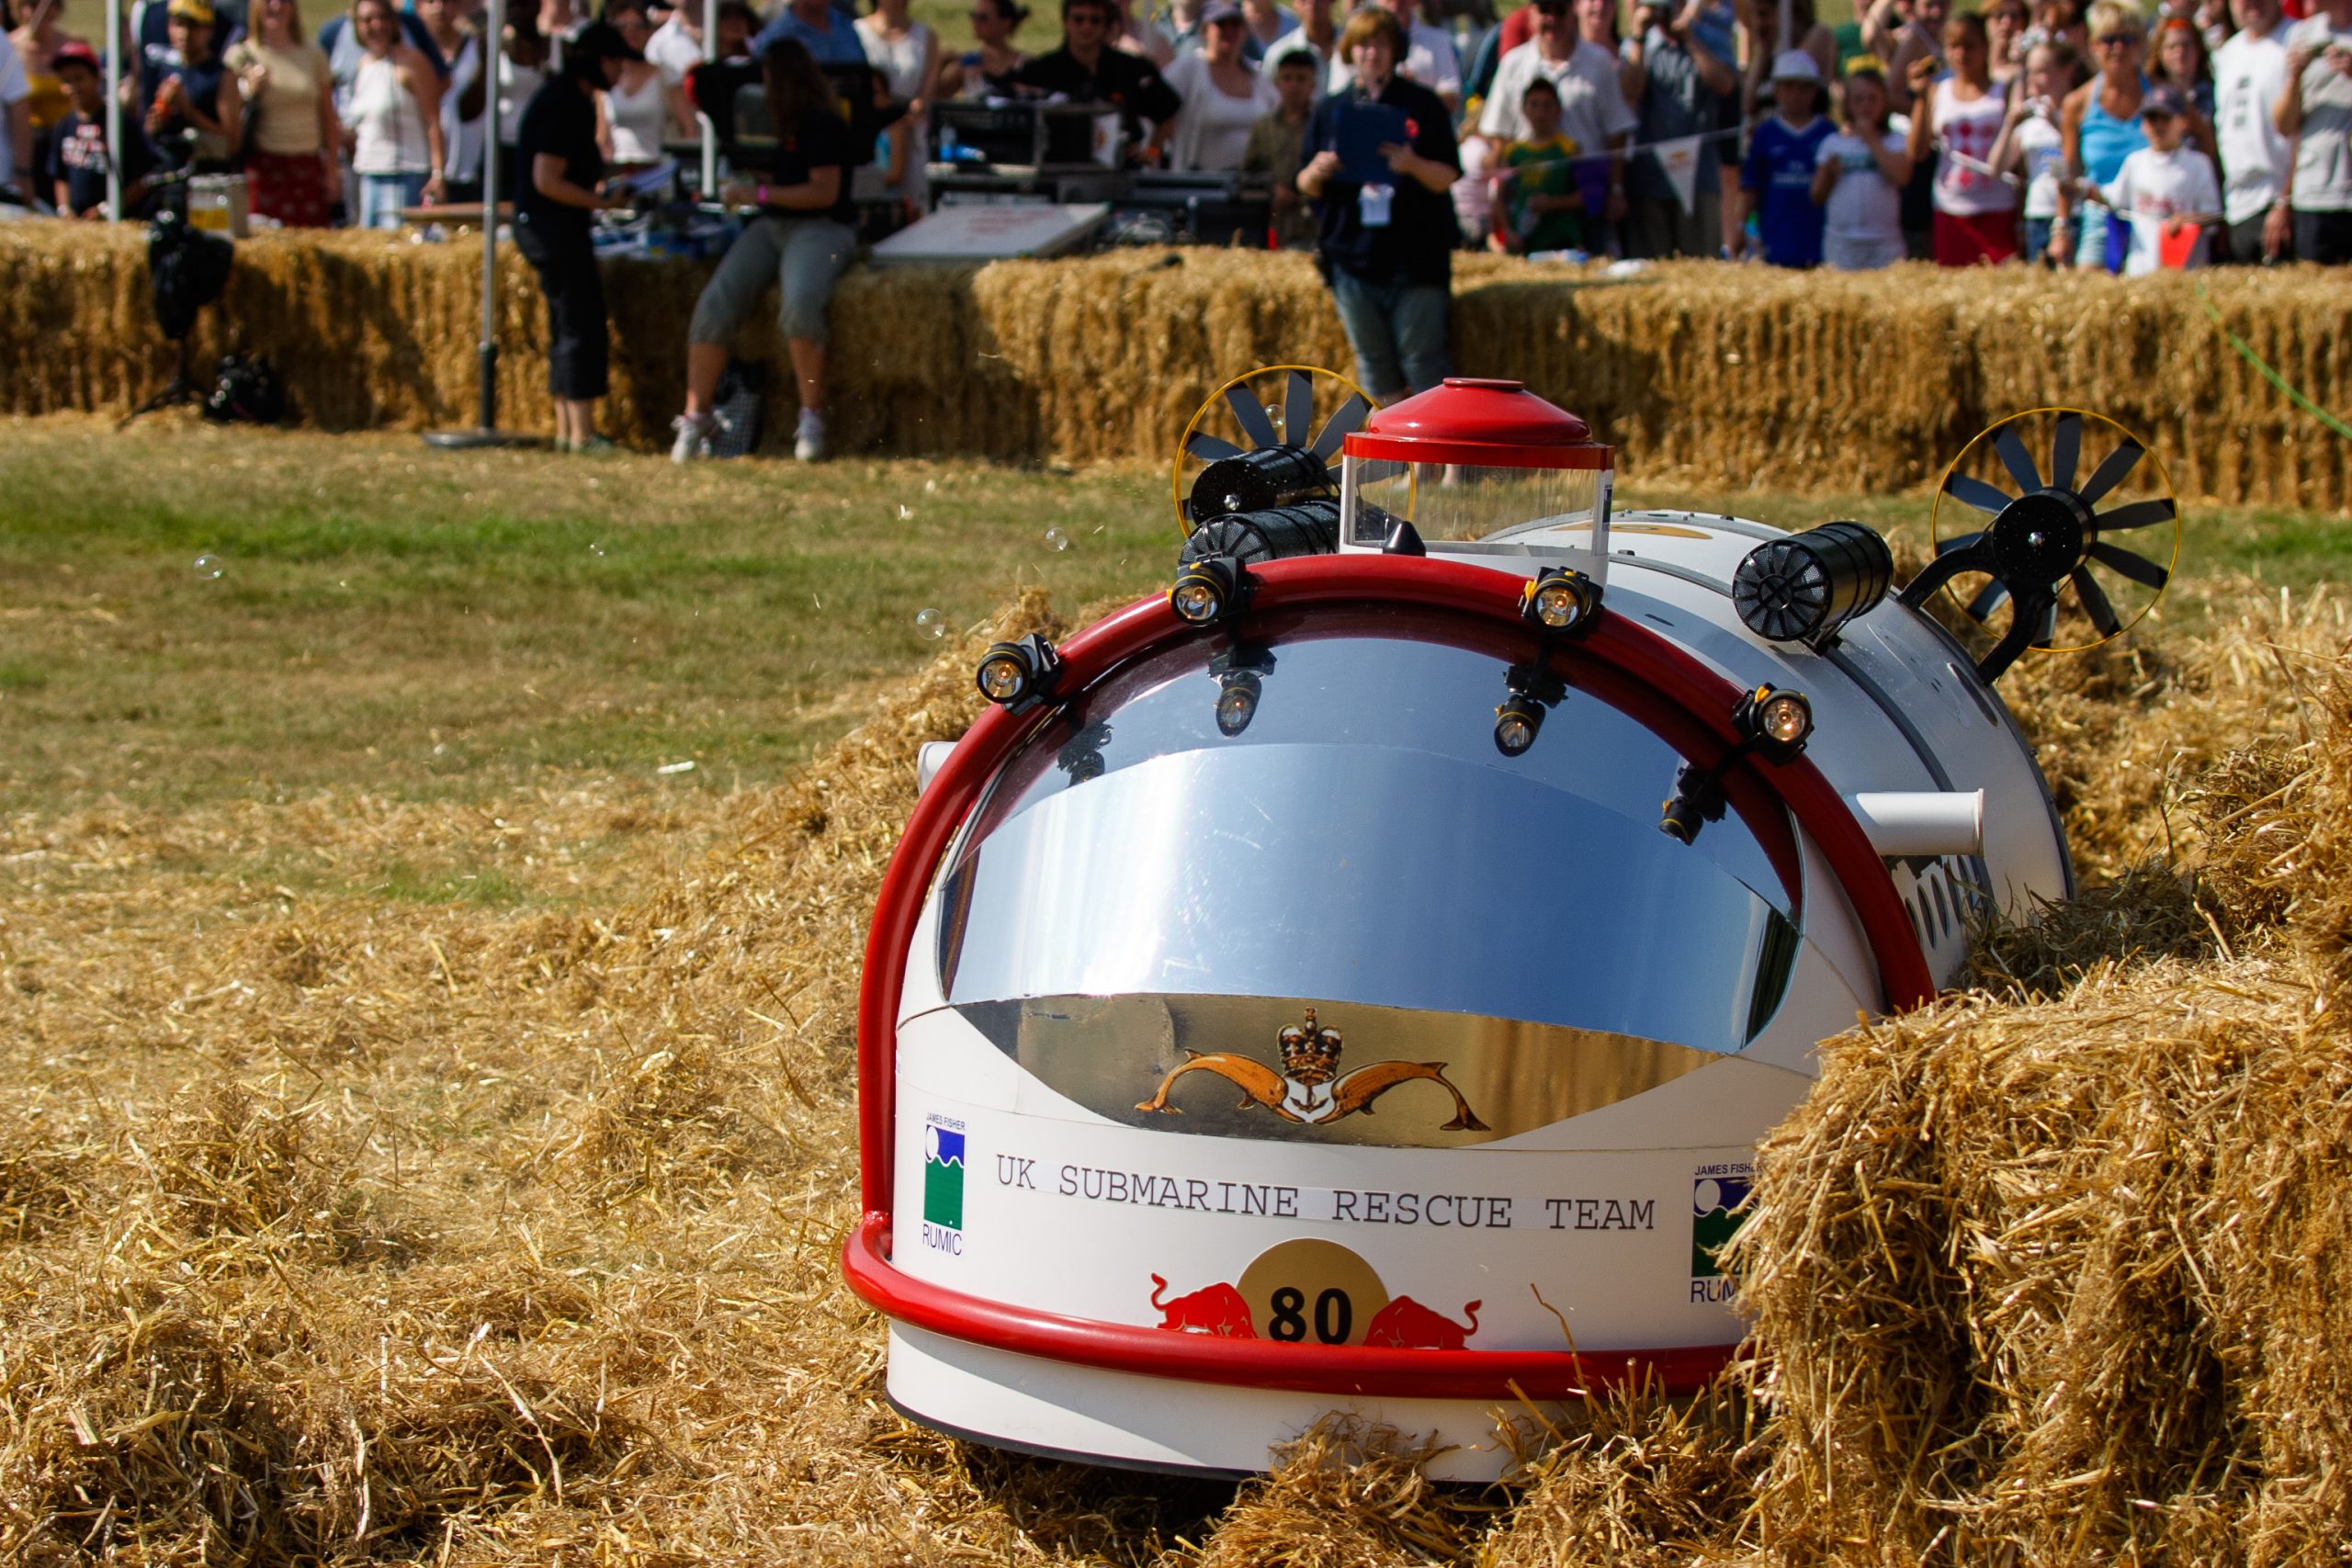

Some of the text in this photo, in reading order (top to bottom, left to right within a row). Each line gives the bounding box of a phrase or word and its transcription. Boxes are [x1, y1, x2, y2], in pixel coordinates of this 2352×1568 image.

[926, 1111, 966, 1131] JAMES FISHER
[1694, 1164, 1728, 1176] JAMES
[996, 1154, 1656, 1231] UK SUBMARINE RESCUE TEAM
[922, 1224, 963, 1256] RUMIC
[1690, 1278, 1740, 1303] RUM
[1268, 1286, 1352, 1346] 80
